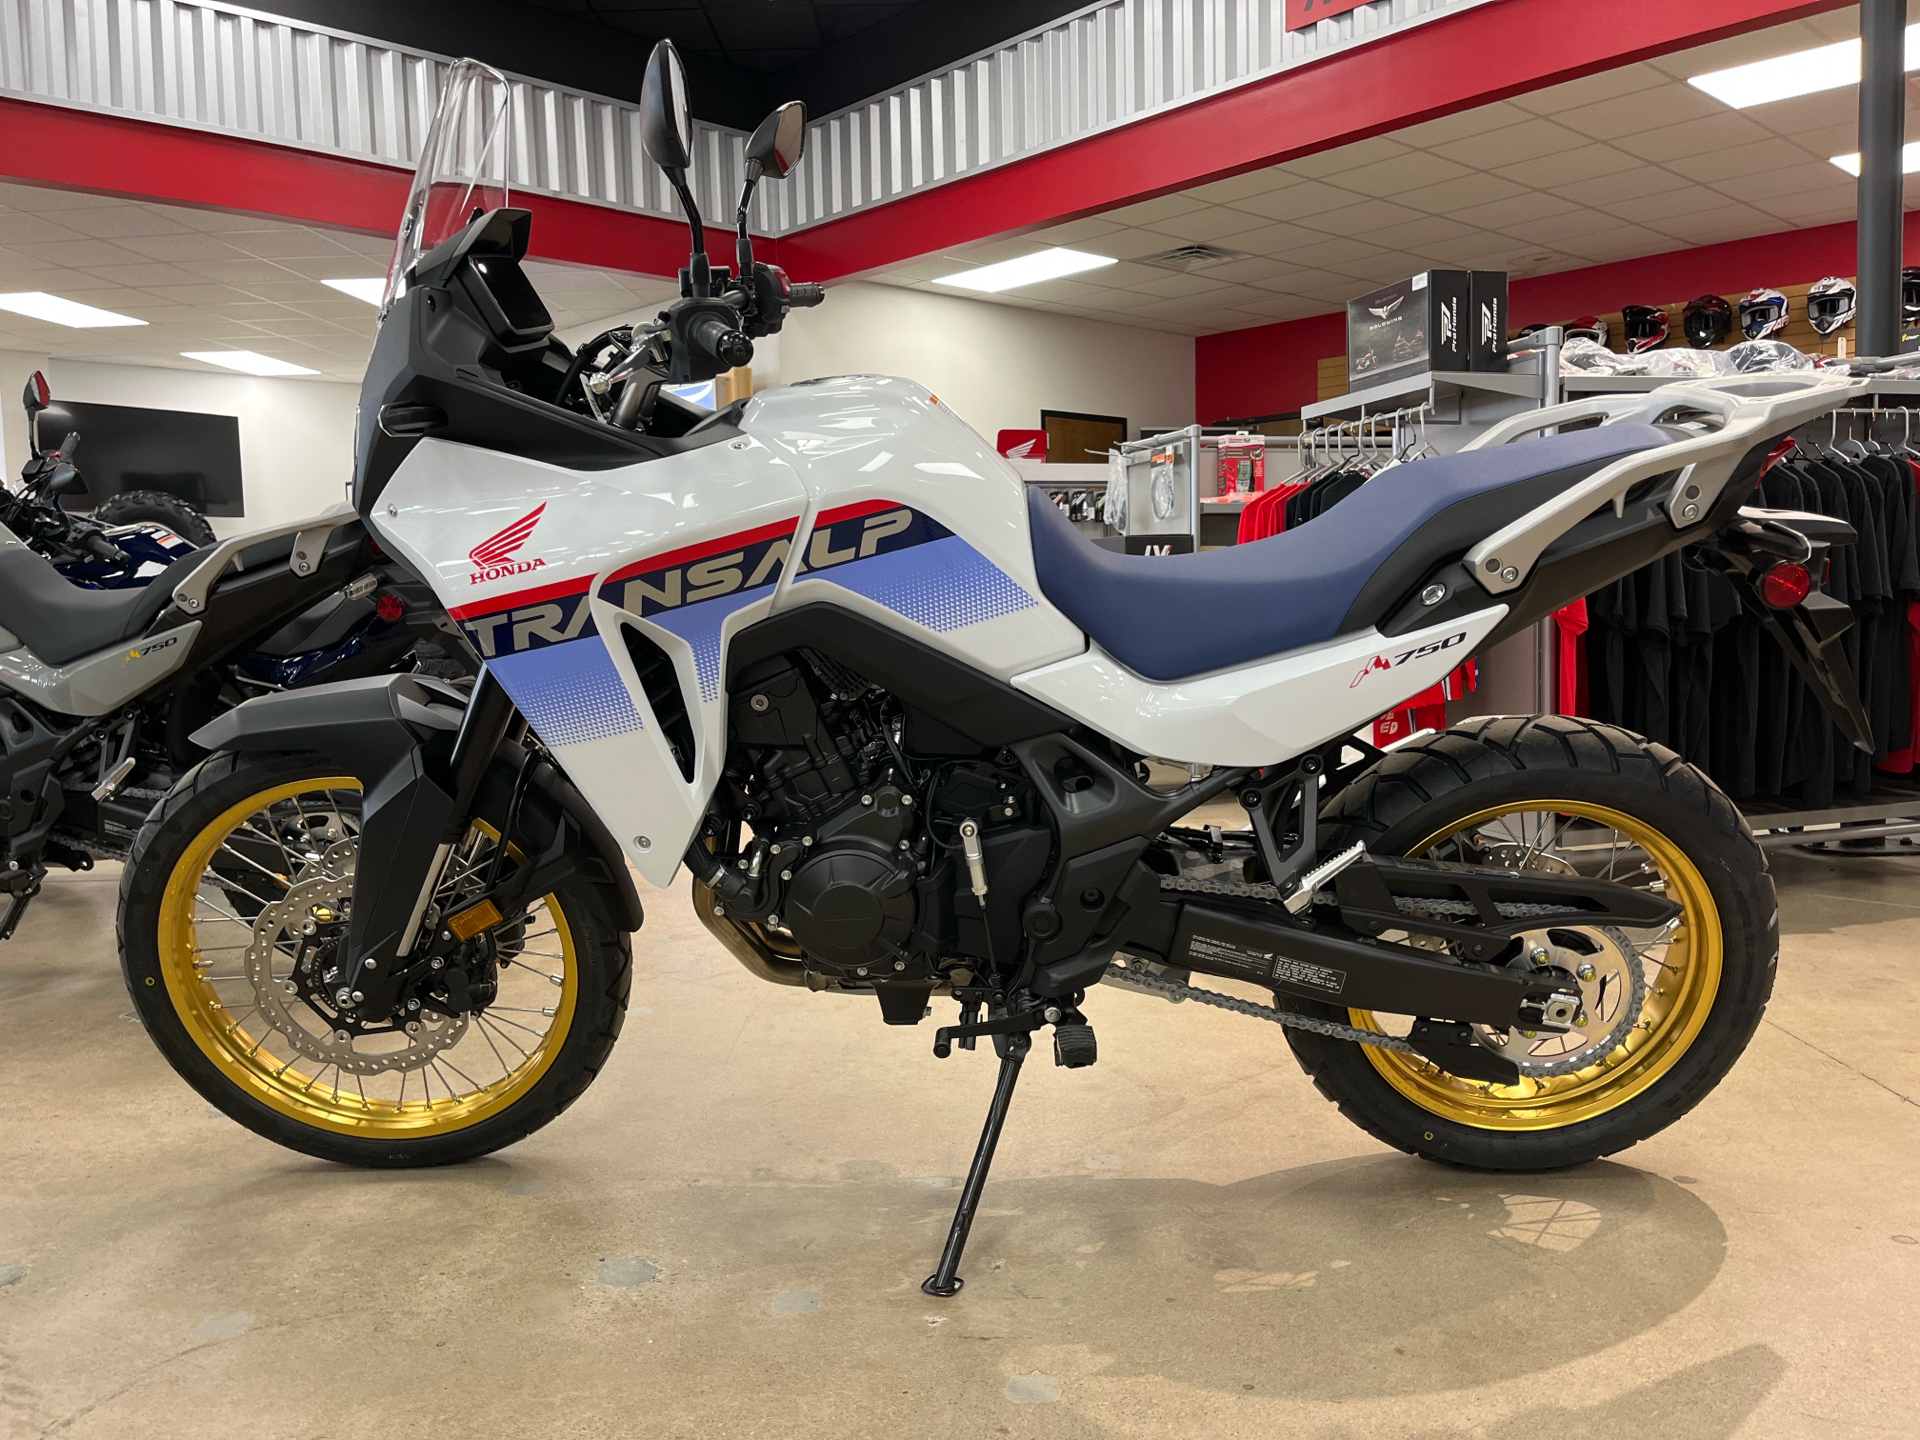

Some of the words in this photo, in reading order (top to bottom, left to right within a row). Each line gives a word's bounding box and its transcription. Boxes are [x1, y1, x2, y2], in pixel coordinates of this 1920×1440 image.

[464, 508, 913, 657] TRANSALP
[469, 557, 547, 585] HONDA
[140, 636, 178, 656] 750
[1393, 631, 1467, 666] 750
